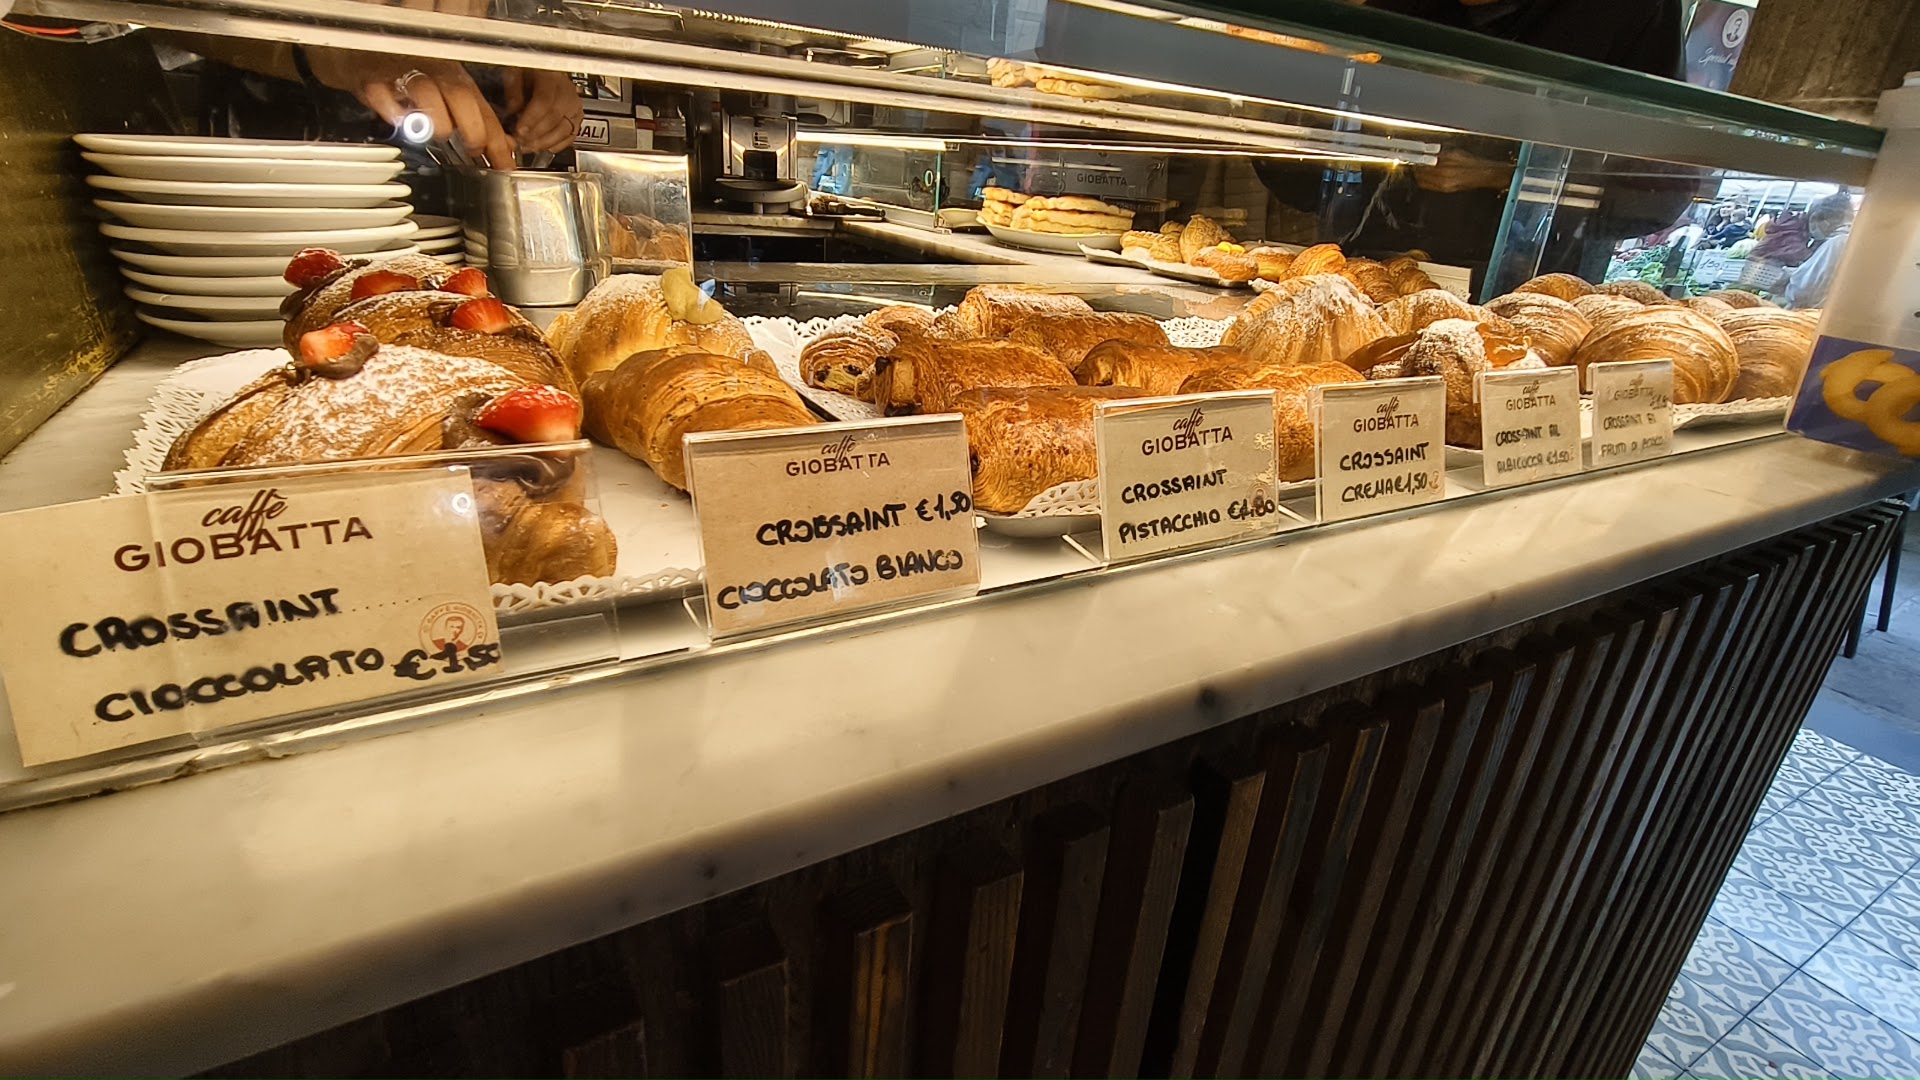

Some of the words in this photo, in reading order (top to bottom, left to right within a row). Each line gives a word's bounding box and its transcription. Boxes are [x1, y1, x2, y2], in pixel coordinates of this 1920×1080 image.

[1076, 172, 1128, 187] GIOBATTA
[1376, 396, 1400, 420] caffè
[1505, 394, 1556, 411] GIOBATTA
[1173, 407, 1204, 437] caffè
[1353, 413, 1419, 433] GIOBATTA
[821, 434, 857, 463] caffè
[1141, 426, 1233, 456] GIOBATTA
[785, 452, 891, 477] GIOBATTA
[1339, 442, 1430, 471] CROSSAINT
[1121, 468, 1228, 504] CROSSAINT
[1341, 477, 1393, 503] CREMA
[200, 488, 289, 541] caffè
[915, 490, 972, 521] €1,50
[1118, 508, 1221, 544] PISTACCHIO
[113, 516, 374, 572] GIOBATTA
[717, 562, 869, 610] CIOCCOLATO
[876, 549, 963, 580] BIANCO
[58, 587, 340, 658] CROSSAINT
[93, 647, 385, 723] CIOCCOLATO
